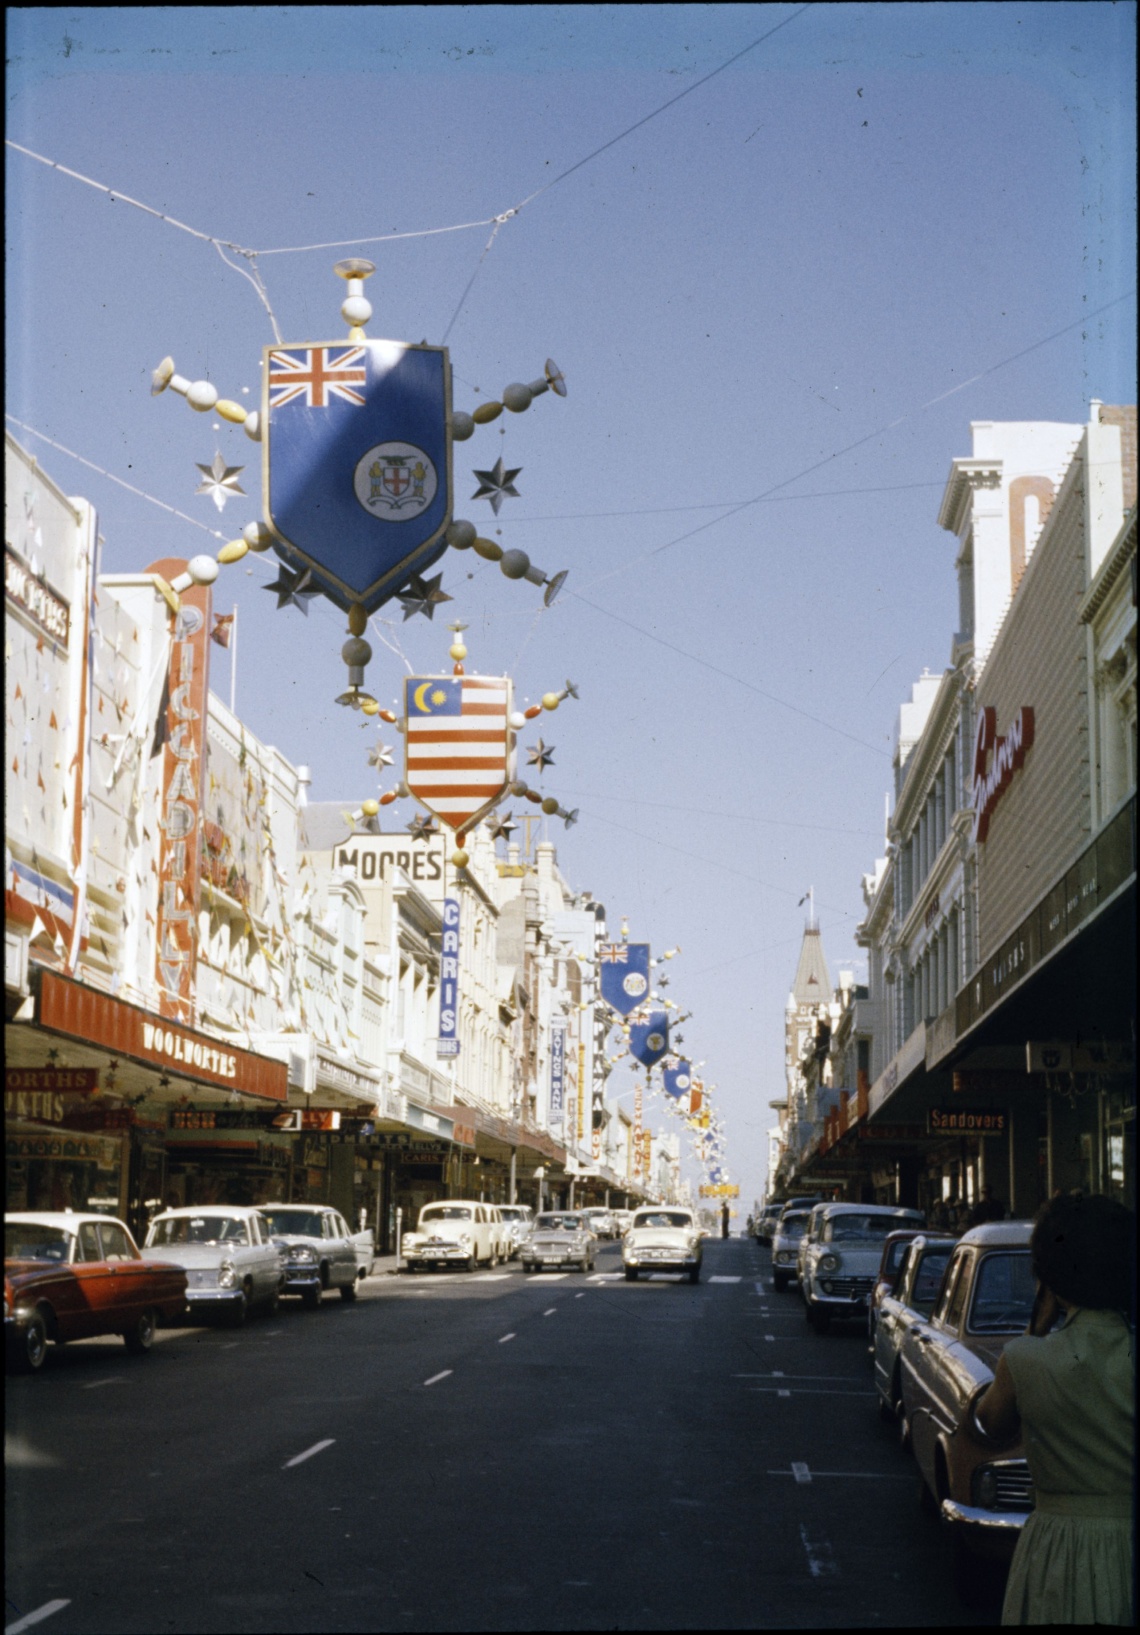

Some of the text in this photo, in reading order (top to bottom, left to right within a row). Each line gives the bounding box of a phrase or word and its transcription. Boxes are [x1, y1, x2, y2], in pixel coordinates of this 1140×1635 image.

[159, 603, 204, 1002] PICCADILLY
[339, 849, 442, 880] MOORES
[440, 903, 459, 1033] CARIS
[142, 1022, 237, 1079] WOOLWORTHS
[551, 1028, 562, 1077] SAVINGS
[593, 1021, 605, 1112] PLAZA
[550, 1080, 562, 1110] BANK
[930, 1108, 1004, 1130] Sandovers
[404, 1153, 440, 1162] CARIS
